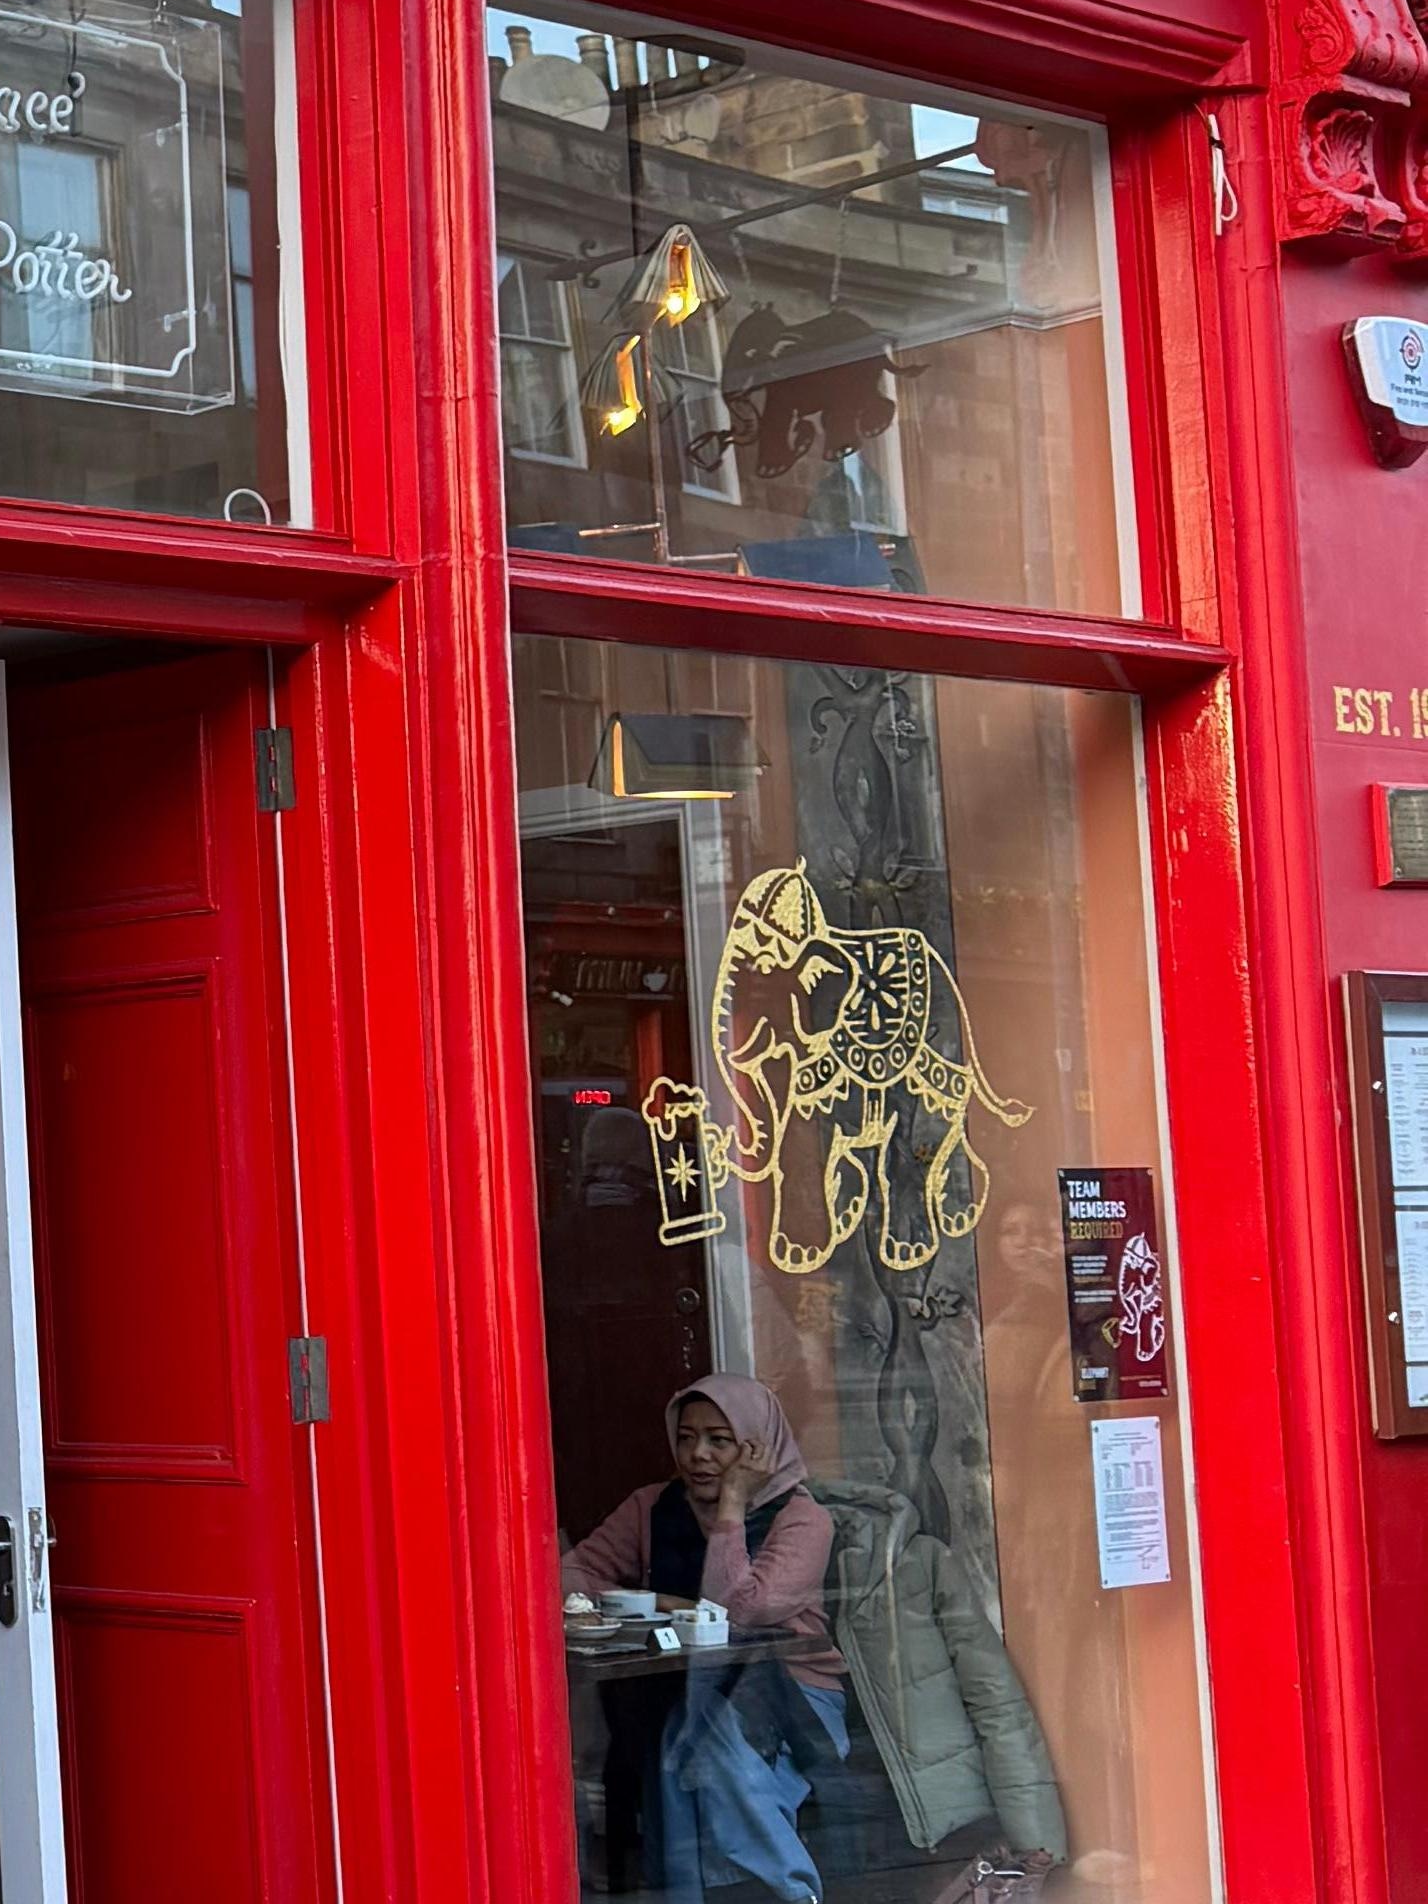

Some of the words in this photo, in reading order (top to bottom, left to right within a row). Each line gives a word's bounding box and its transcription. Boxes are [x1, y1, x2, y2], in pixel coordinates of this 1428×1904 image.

[1333, 686, 1401, 737] EST.
[1067, 1181, 1100, 1198] TEAM
[1069, 1201, 1126, 1218] MEMBERS
[1070, 1221, 1123, 1239] REQUIRED
